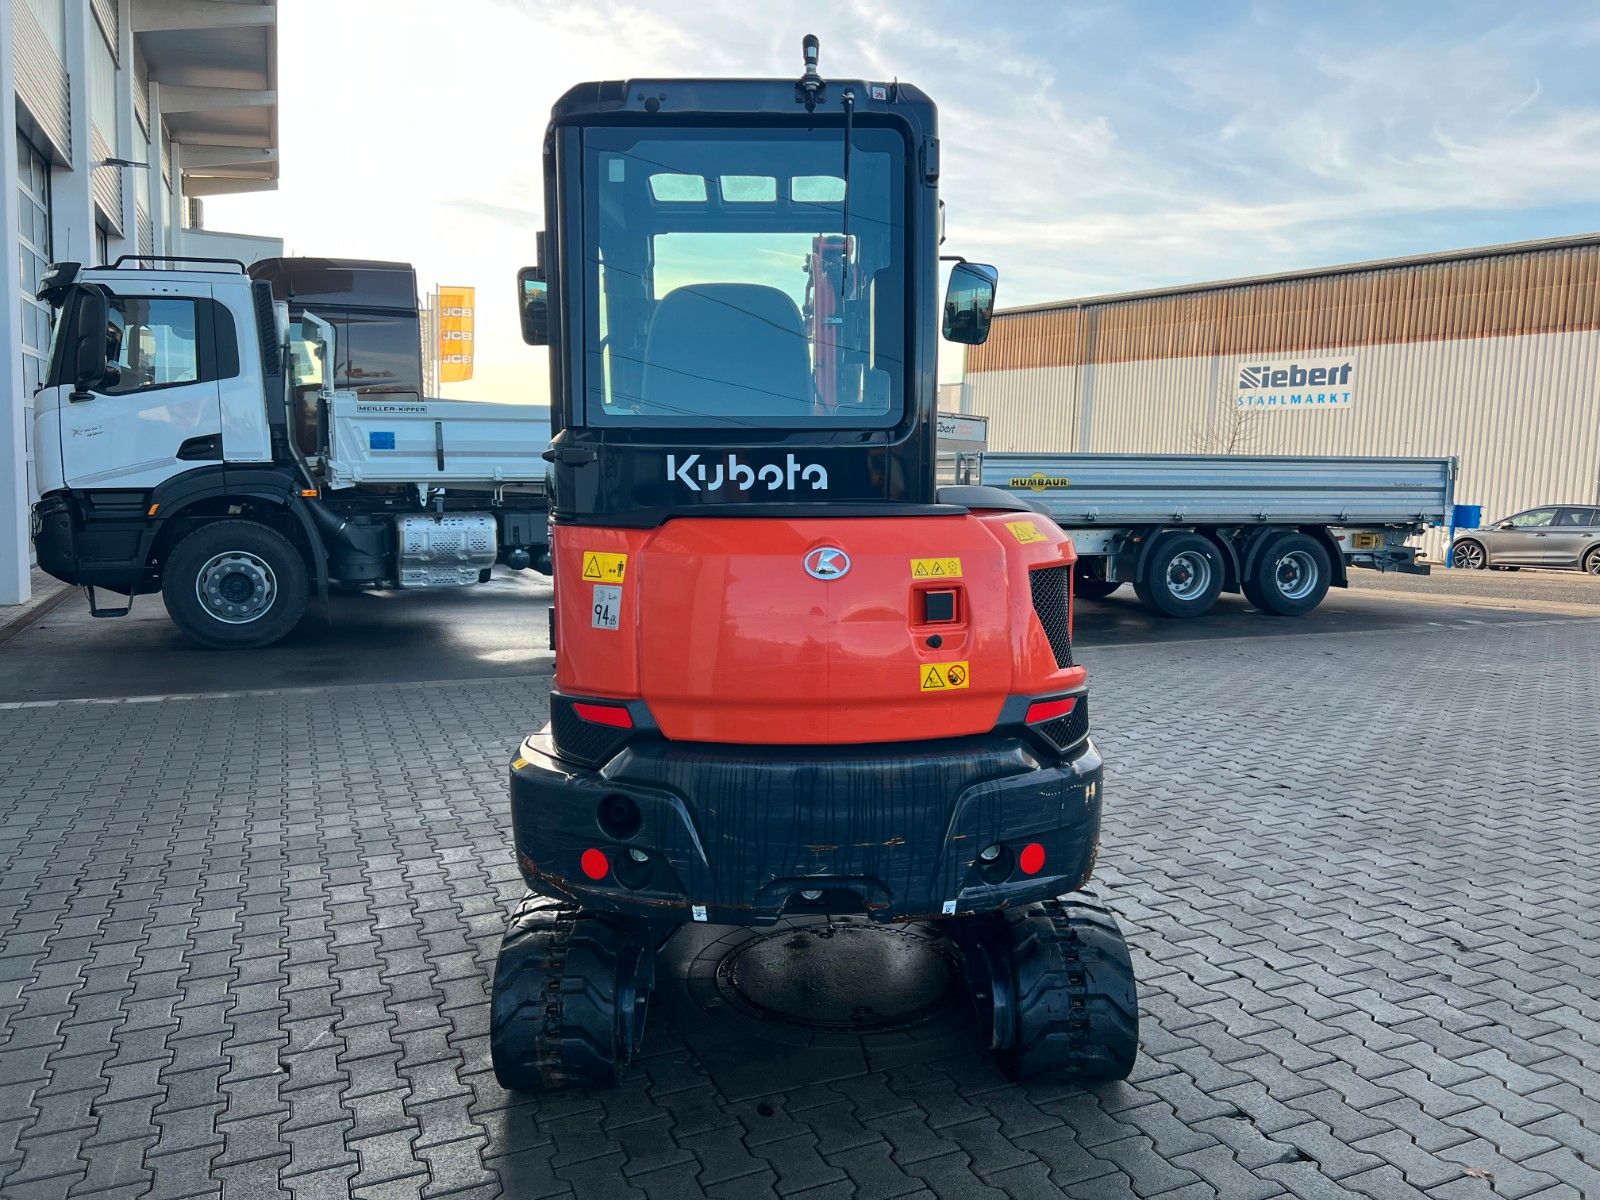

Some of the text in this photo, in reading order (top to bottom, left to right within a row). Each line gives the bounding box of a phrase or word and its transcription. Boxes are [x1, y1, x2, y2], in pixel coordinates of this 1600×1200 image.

[442, 307, 473, 317] JCB
[442, 331, 473, 341] JCB
[442, 354, 472, 364] JCB
[1239, 362, 1352, 389] Siebert
[1237, 392, 1351, 406] STAHLMARKT
[666, 453, 828, 491] Kubota
[1011, 478, 1068, 486] HUMBAUR
[594, 603, 610, 626] 94
